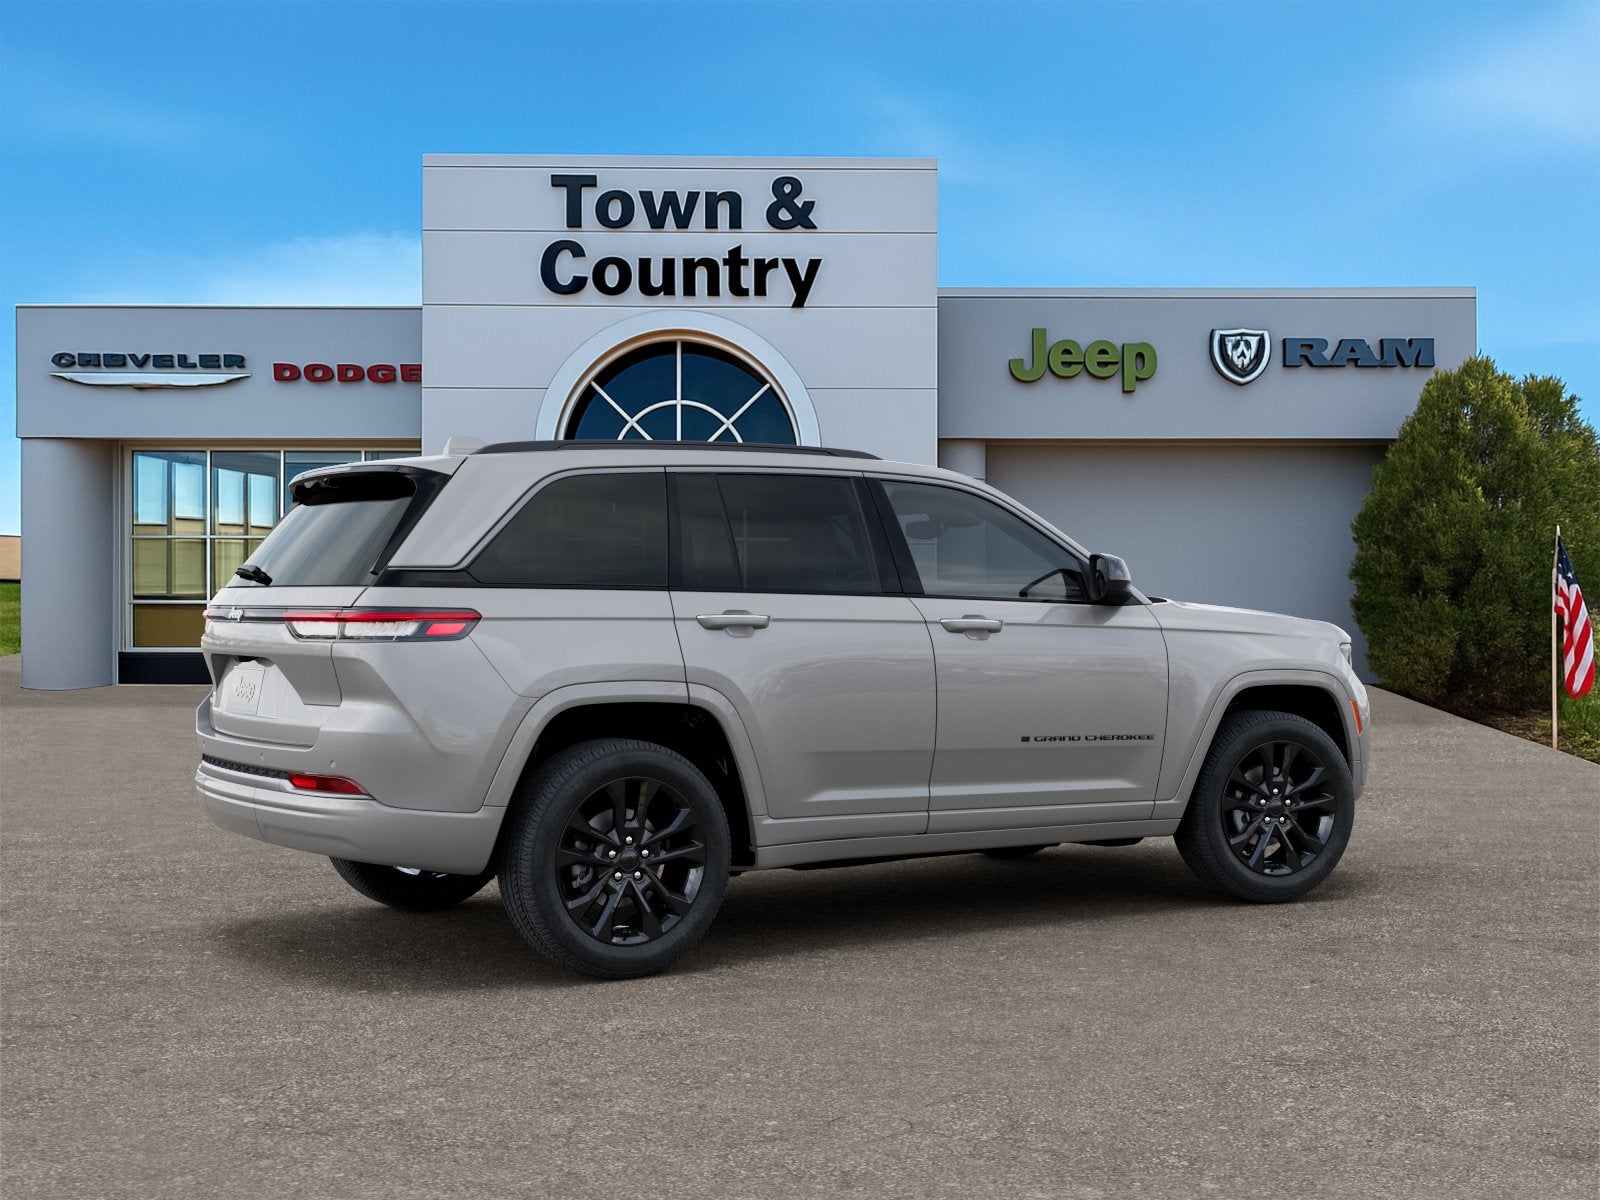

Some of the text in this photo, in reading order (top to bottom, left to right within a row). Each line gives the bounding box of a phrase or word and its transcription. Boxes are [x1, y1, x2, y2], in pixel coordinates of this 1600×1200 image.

[550, 174, 818, 229] Town &
[540, 239, 822, 308] Country
[273, 363, 422, 383] DODGE
[1009, 328, 1157, 392] Jeep
[1283, 337, 1435, 368] RAM
